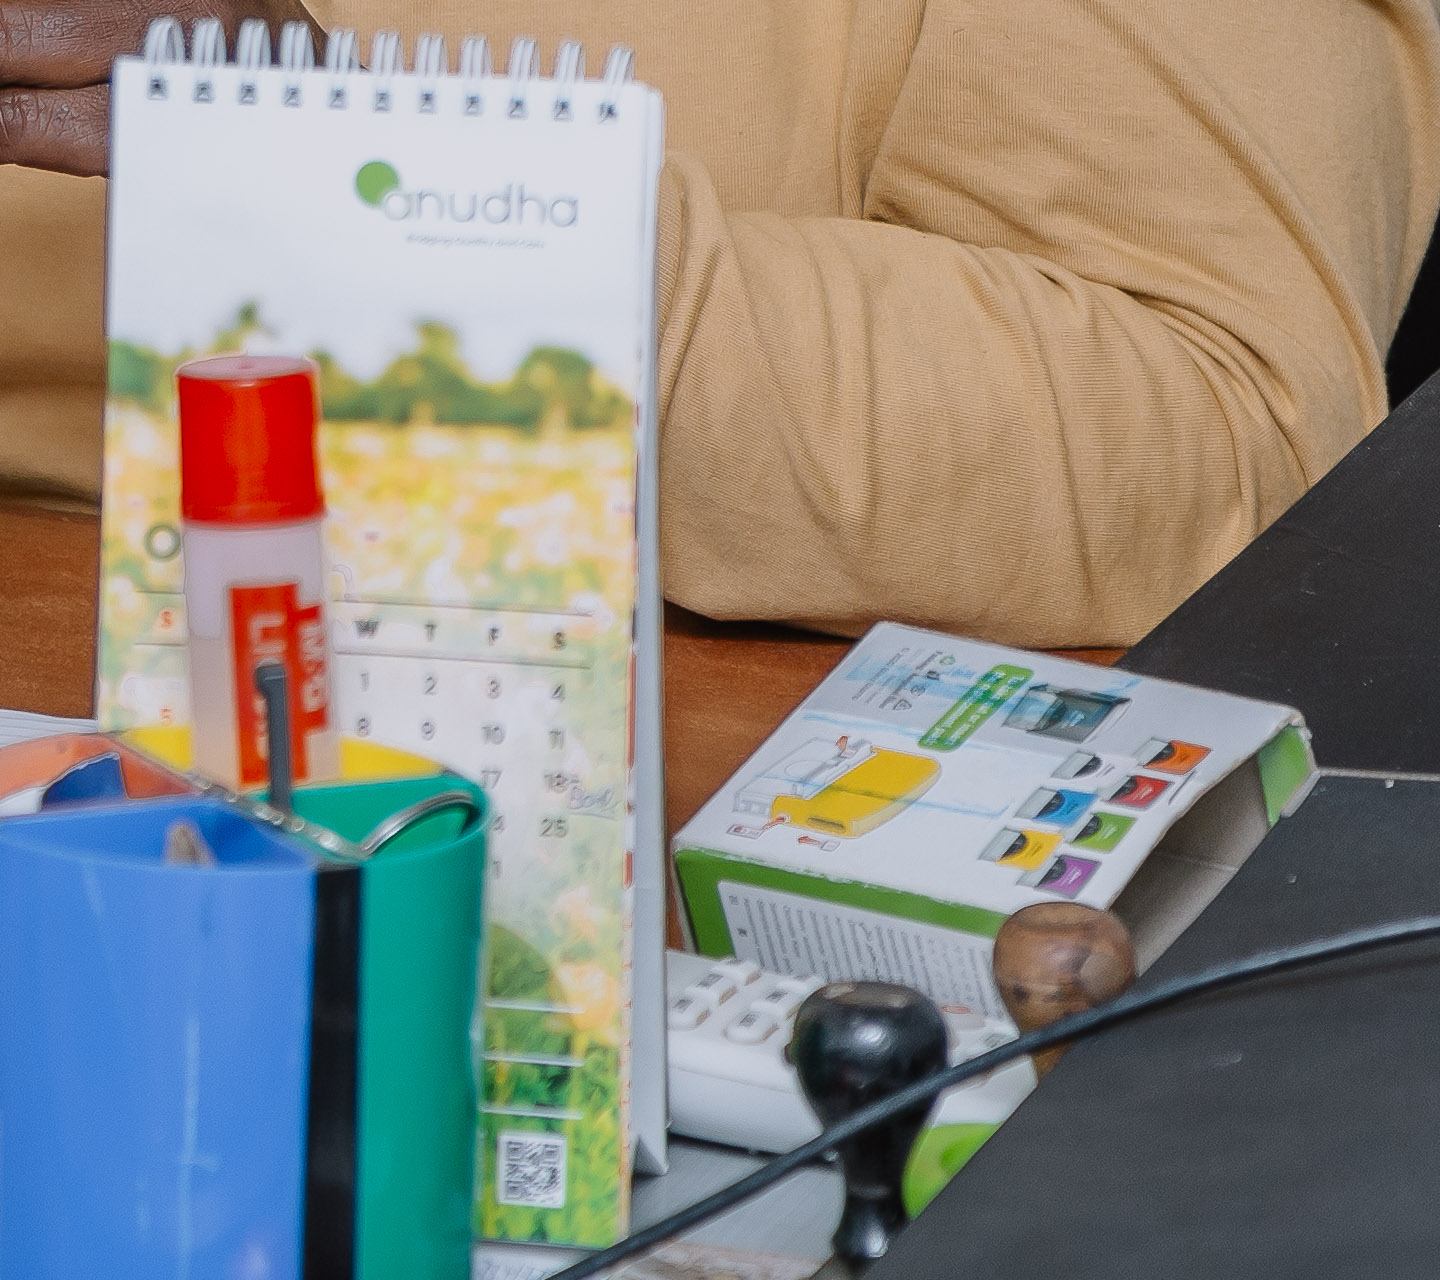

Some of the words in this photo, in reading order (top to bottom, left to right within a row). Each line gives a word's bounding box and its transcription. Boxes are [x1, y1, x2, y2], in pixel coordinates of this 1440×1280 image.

[355, 619, 381, 637] W
[424, 622, 438, 640] T
[359, 671, 371, 692] 1
[424, 676, 439, 697] 2
[486, 678, 502, 700] 3
[551, 682, 567, 703] 4
[355, 718, 373, 739] 8
[421, 720, 437, 741] 9
[482, 724, 507, 745] 10
[548, 729, 567, 750] 11
[540, 818, 569, 839] 25
